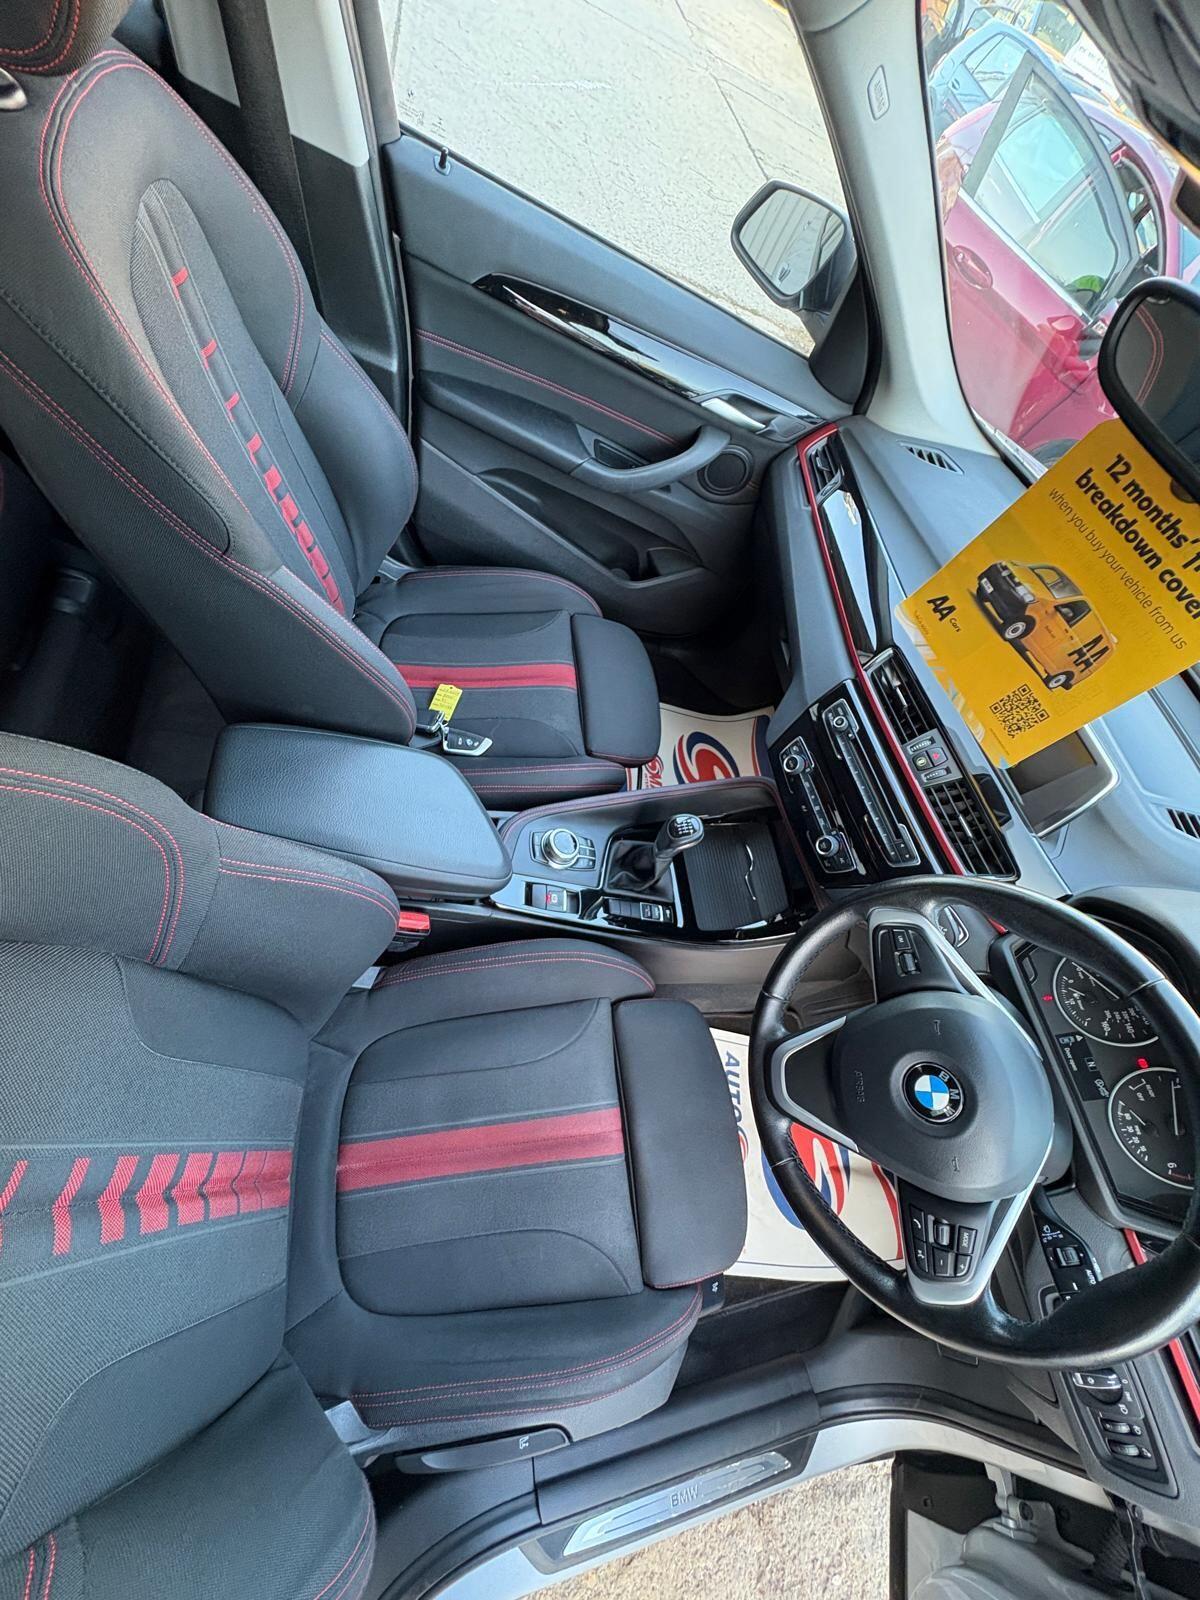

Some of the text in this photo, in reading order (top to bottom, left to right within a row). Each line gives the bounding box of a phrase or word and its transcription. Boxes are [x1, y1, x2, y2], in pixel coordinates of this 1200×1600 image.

[1105, 453, 1132, 484] 12
[1075, 467, 1163, 570] breakdown
[1049, 487, 1187, 650] when you buy your vehicle from us
[926, 595, 956, 622] AA
[1067, 634, 1109, 673] AA
[1101, 1021, 1111, 1032] 160
[939, 1071, 960, 1117] BMW
[961, 1231, 969, 1248] MODE
[1085, 1269, 1097, 1285] AUTO
[671, 1484, 698, 1507] BMW
